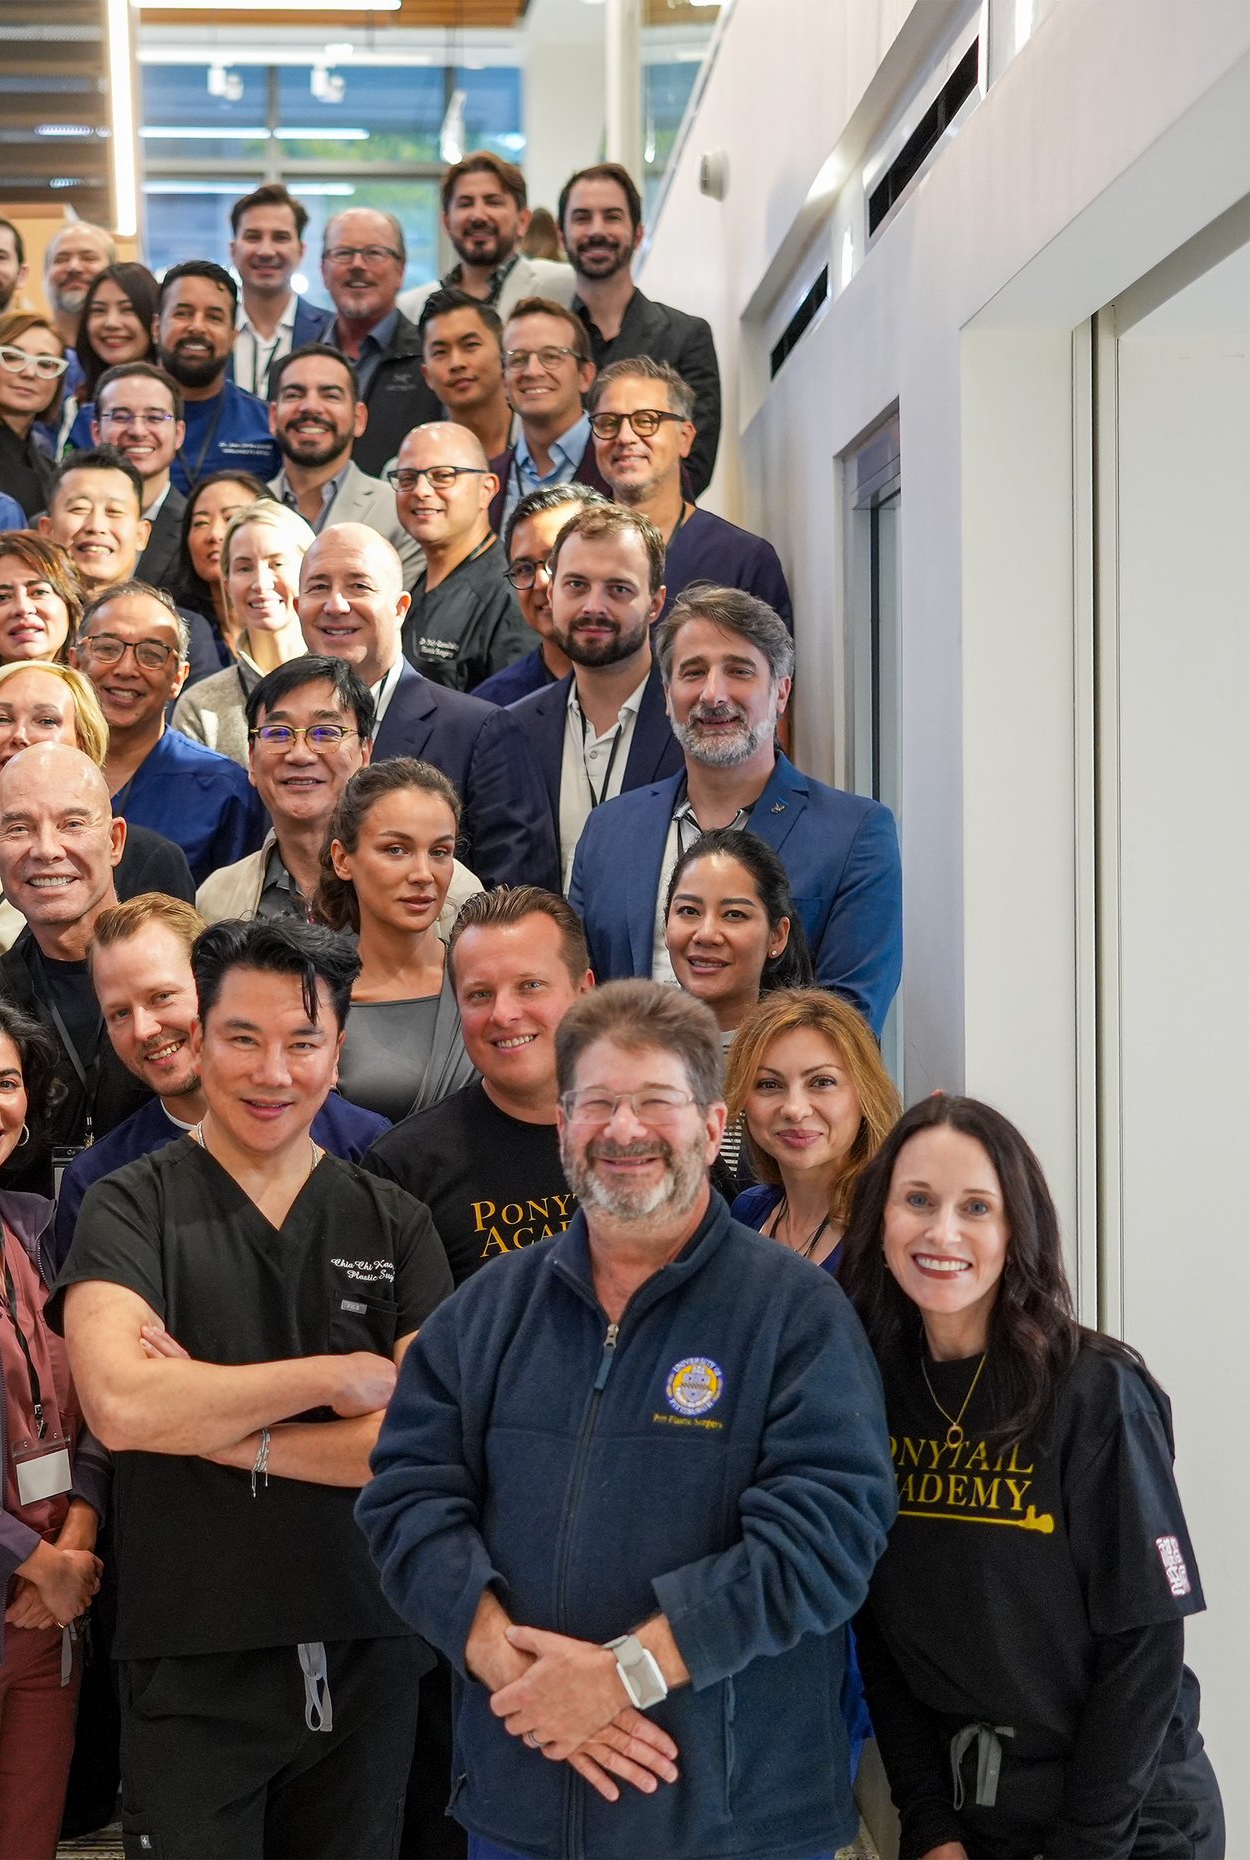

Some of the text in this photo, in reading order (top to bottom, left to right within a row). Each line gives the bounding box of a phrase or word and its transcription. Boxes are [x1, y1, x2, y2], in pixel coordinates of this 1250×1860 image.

[470, 1193, 578, 1232] PONY
[347, 1269, 378, 1281] Plastic
[895, 1473, 1032, 1511] ADEMY
